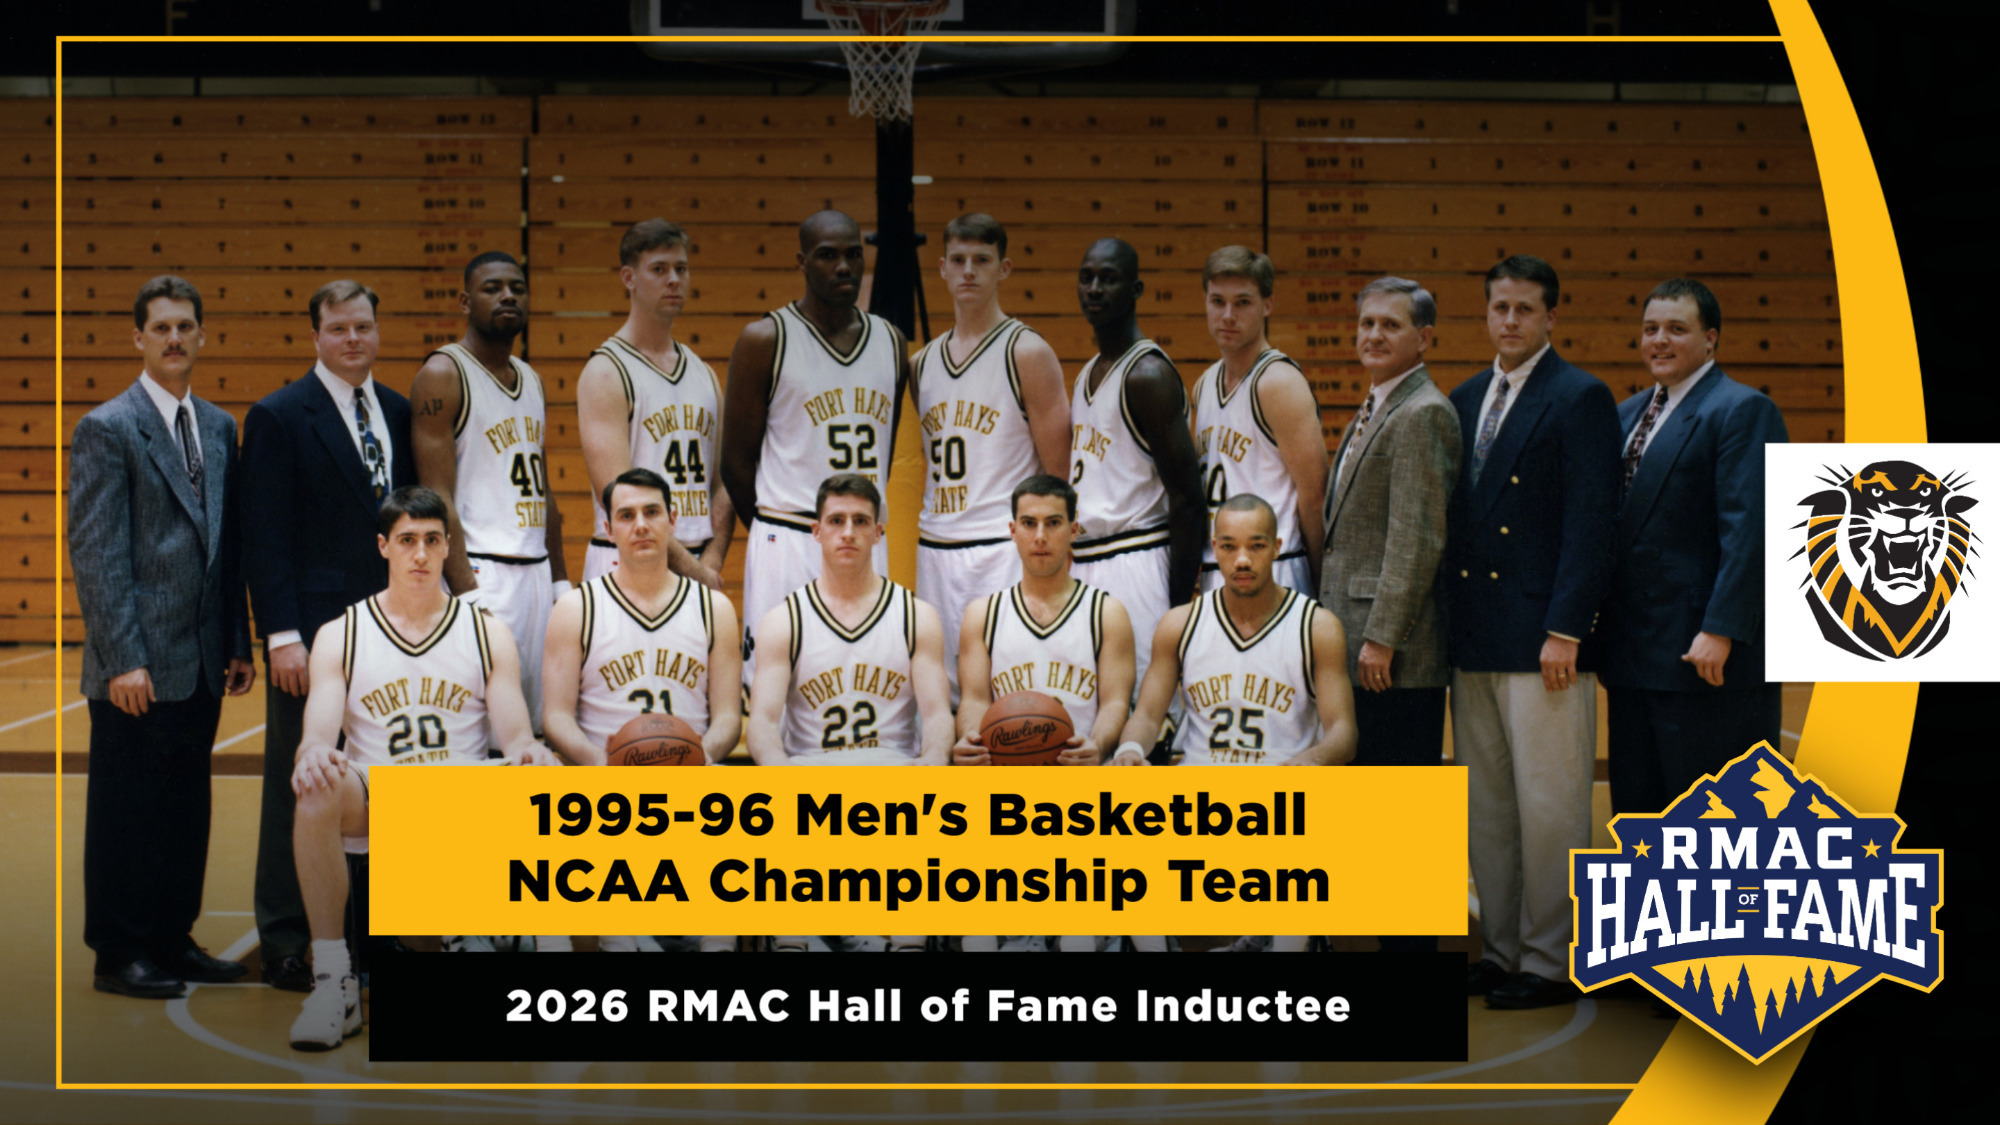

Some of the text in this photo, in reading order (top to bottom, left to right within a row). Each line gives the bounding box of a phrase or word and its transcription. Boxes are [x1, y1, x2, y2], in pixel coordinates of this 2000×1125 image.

[437, 113, 470, 125] ROW
[1296, 117, 1330, 129] ROW
[425, 153, 482, 165] ROW 11
[1306, 157, 1363, 169] ROW 11
[424, 198, 485, 209] ROW 10
[1307, 202, 1369, 213] ROW 10
[424, 243, 458, 254] ROW
[1307, 246, 1341, 258] ROW
[424, 288, 458, 299] ROW
[1307, 292, 1341, 303] ROW
[1307, 337, 1341, 347] ROW
[642, 404, 680, 443] FORT
[803, 386, 892, 427] FORT HAYS
[953, 400, 1000, 435] HAYS
[485, 416, 522, 455] FORT
[828, 422, 878, 470] 52
[510, 452, 545, 497] 40
[664, 438, 706, 485] 44
[931, 435, 966, 482] 50
[599, 647, 706, 692] FORT HAYS
[798, 663, 907, 711] FORT HAYS
[991, 661, 1097, 701] FORT HAYS
[361, 677, 472, 720] FORT HAYS
[1187, 673, 1296, 714] FORT HAYS
[386, 713, 448, 757] 20
[822, 700, 879, 750] 22
[991, 720, 1057, 749] Rawlings
[1209, 706, 1265, 751] 25
[623, 741, 693, 767] Rawlings
